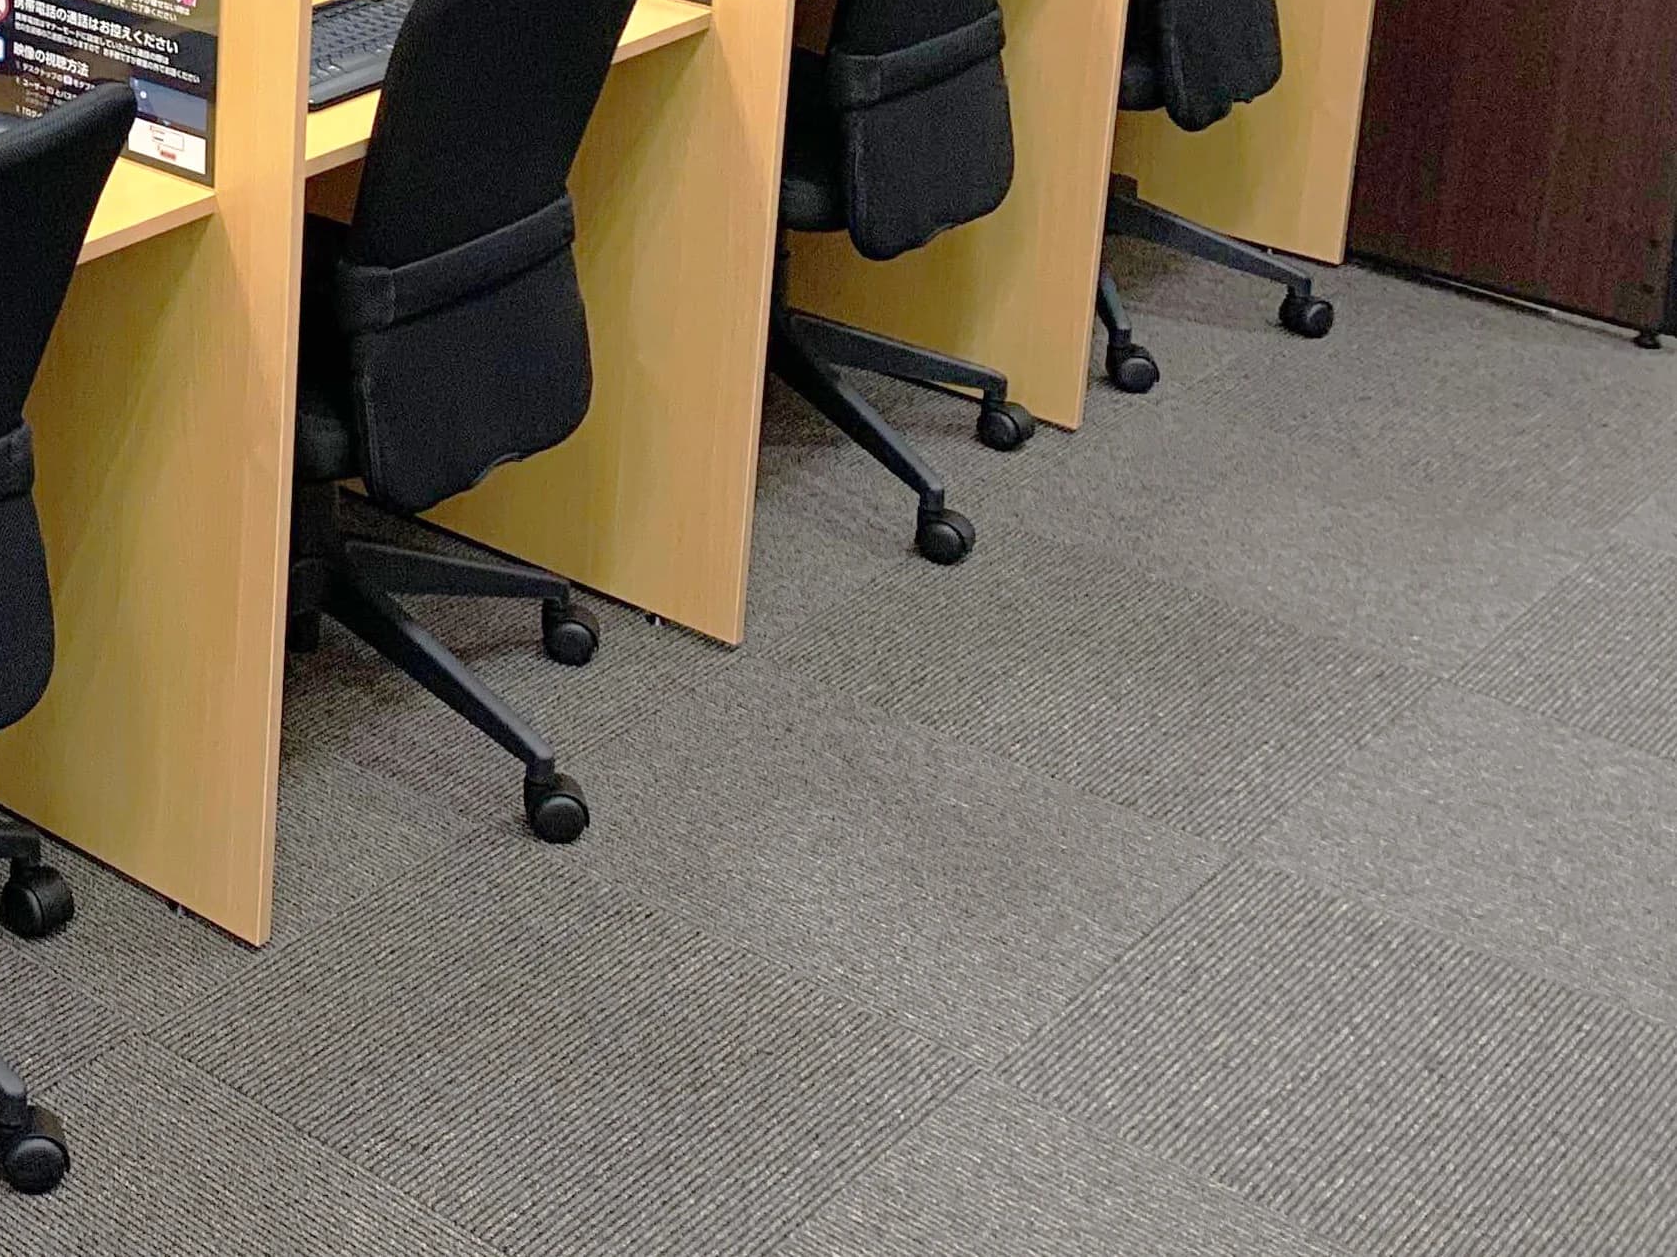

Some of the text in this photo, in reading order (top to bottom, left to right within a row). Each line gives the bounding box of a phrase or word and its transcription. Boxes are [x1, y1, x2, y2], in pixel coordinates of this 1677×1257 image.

[13, 41, 89, 78] 映像の視聴方法
